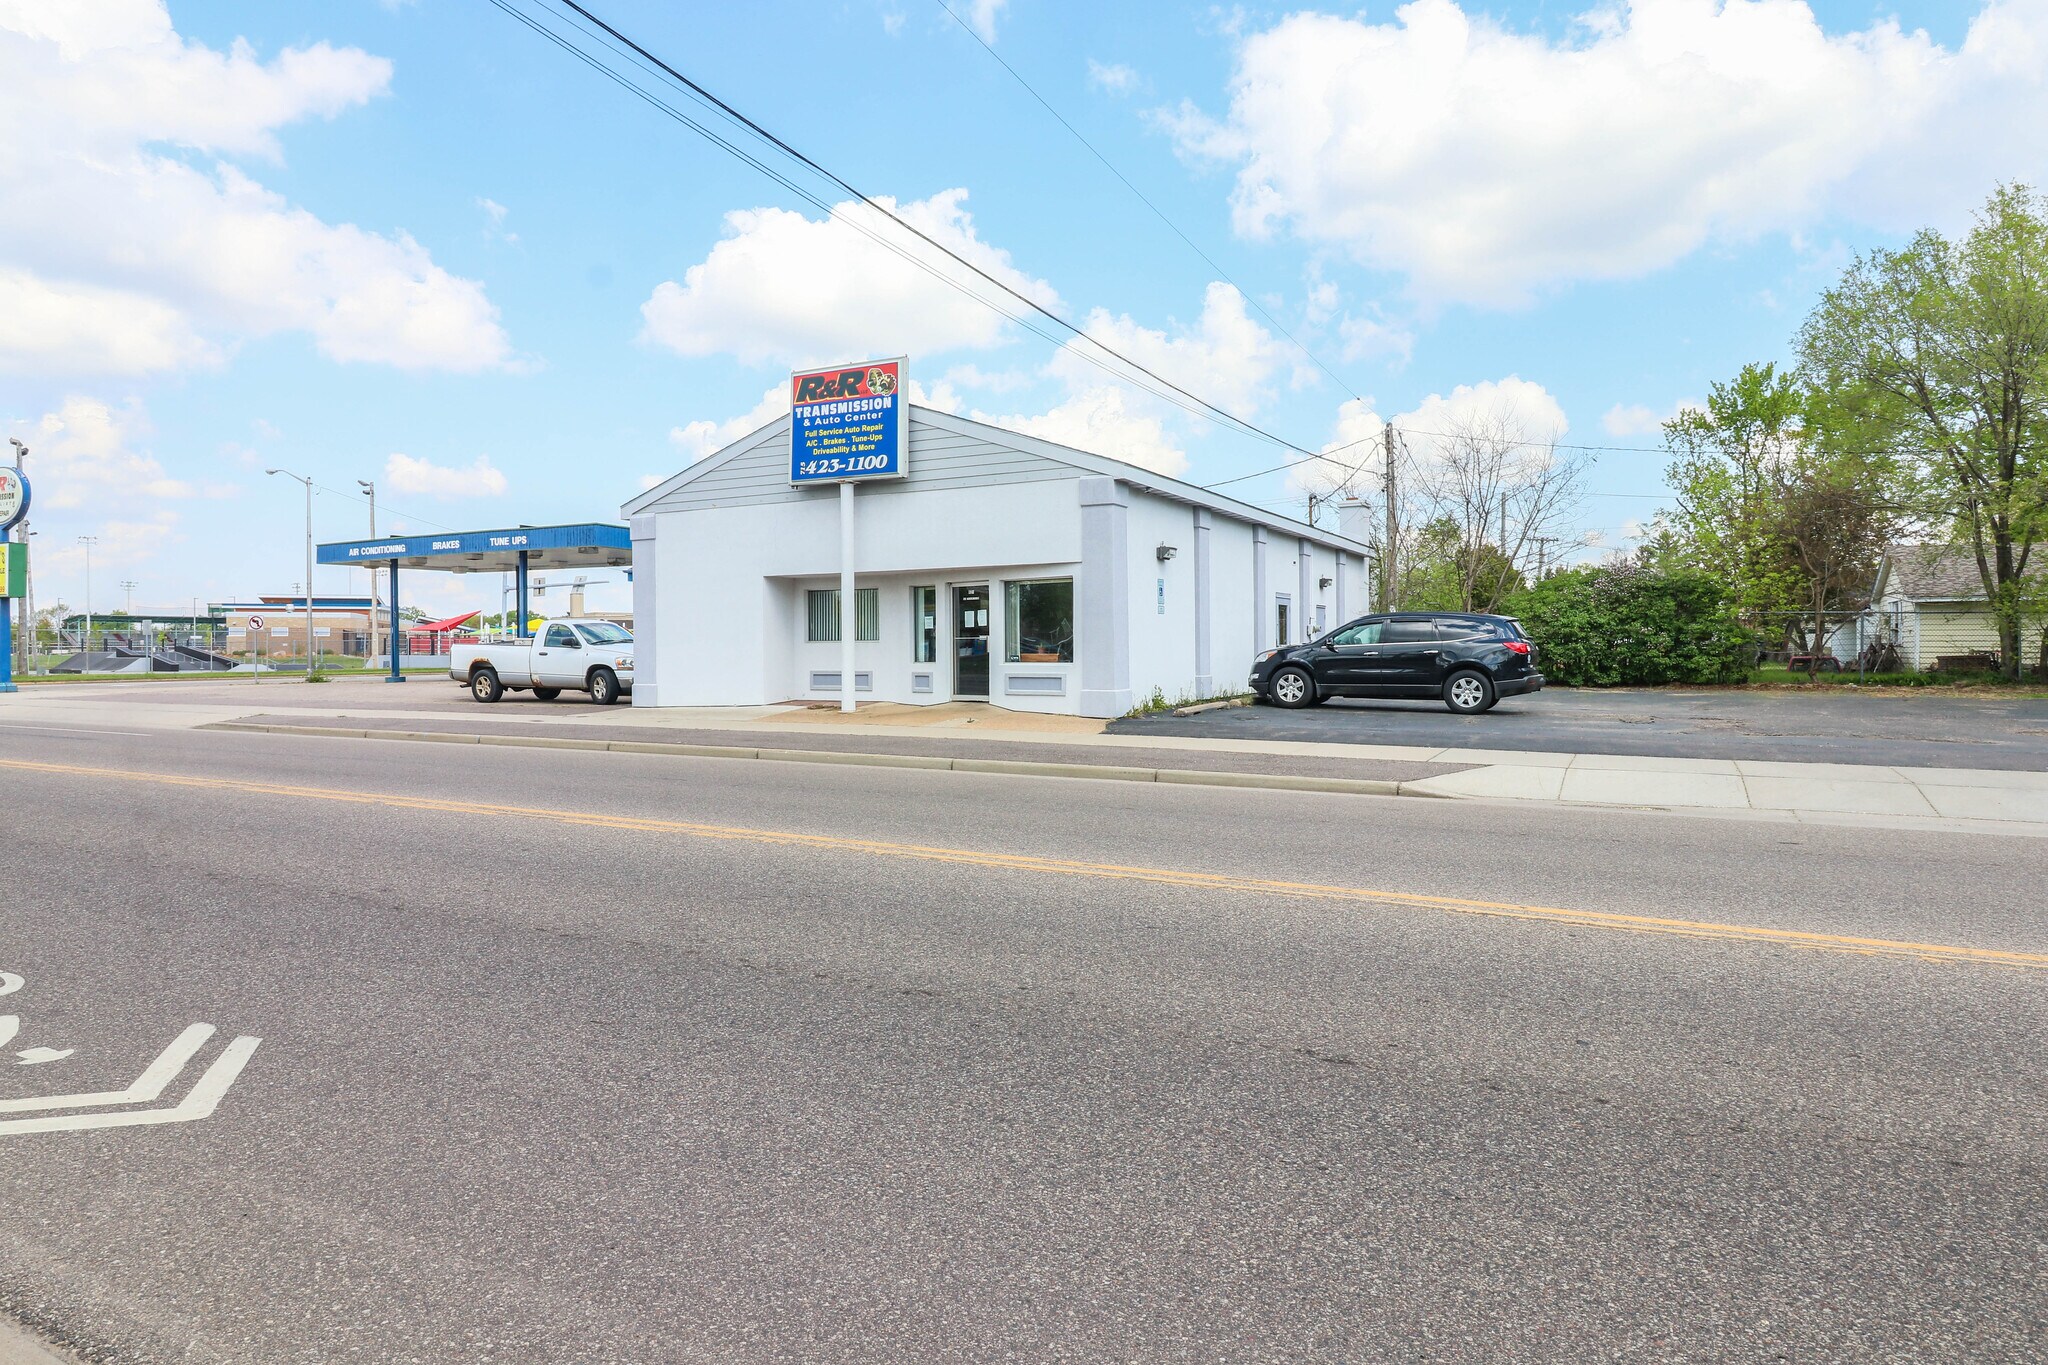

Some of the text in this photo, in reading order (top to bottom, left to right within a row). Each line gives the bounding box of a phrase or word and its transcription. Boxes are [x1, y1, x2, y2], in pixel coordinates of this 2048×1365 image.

[793, 370, 865, 405] R&R
[795, 397, 892, 418] TRANSMISSION
[803, 411, 883, 427] & Auto Center
[805, 423, 884, 438] Full Service Auto Repair
[823, 437, 846, 446] Brakes
[851, 433, 883, 443] Tune-Ups
[813, 446, 850, 456] Driveability
[858, 443, 875, 452] More
[805, 454, 888, 475] 423-1100
[432, 540, 460, 550] BRAKES
[490, 535, 528, 546] TUNE UPS
[349, 544, 406, 557] AIR CONDITIONING
